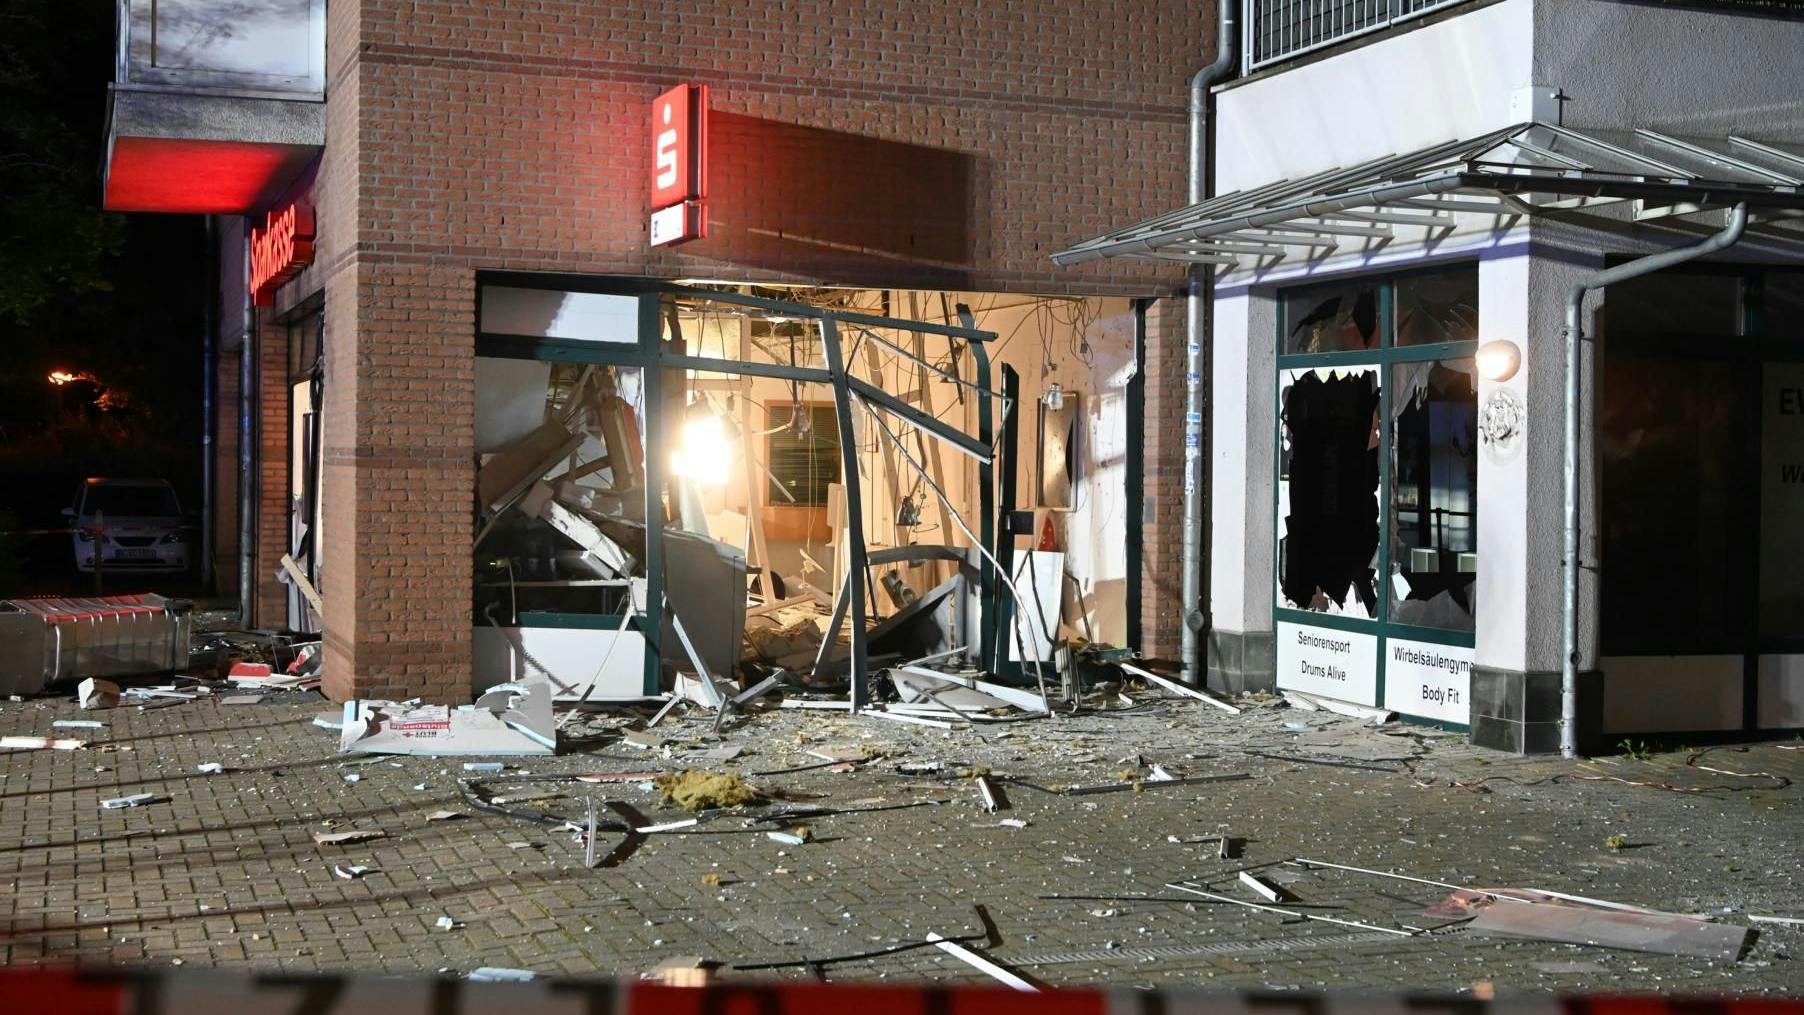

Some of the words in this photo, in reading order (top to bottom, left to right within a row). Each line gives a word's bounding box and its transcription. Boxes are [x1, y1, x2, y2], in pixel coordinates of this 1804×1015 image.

[250, 204, 295, 305] Sparkasse
[1298, 631, 1350, 654] Seniorensport
[1301, 660, 1325, 677] Drums
[1327, 665, 1346, 681] Alive
[1422, 685, 1445, 705] Body
[1447, 688, 1459, 704] Fit
